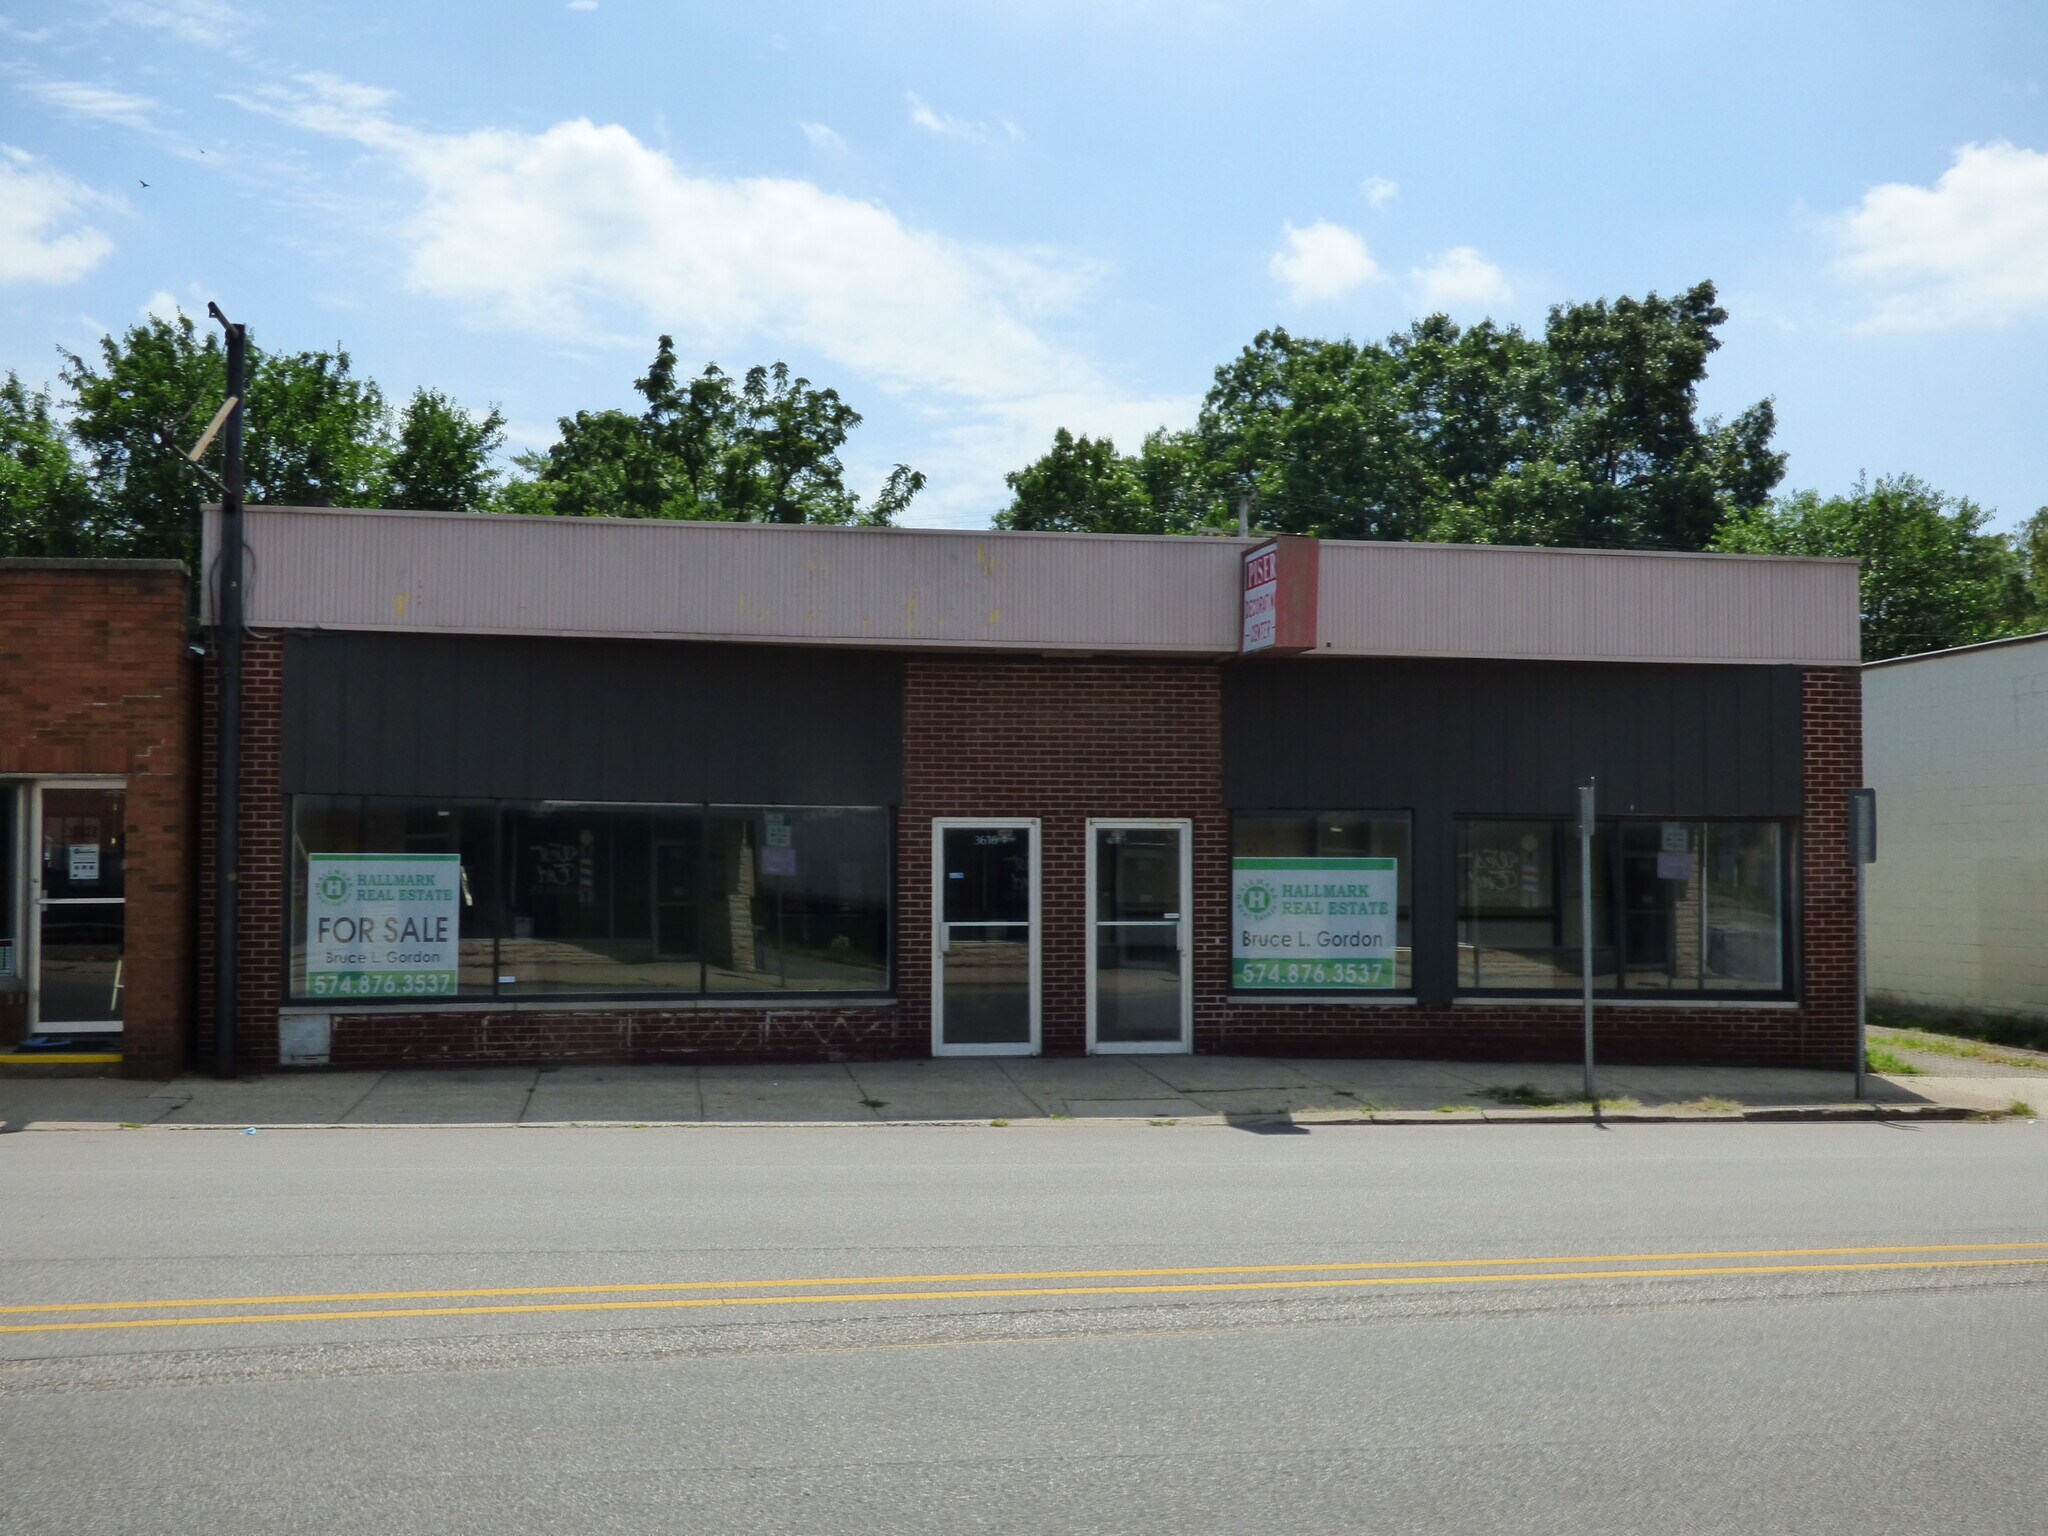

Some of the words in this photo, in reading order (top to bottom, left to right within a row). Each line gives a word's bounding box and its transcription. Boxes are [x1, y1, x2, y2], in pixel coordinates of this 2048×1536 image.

[357, 874, 436, 886] HALLMARK
[357, 889, 394, 901] REAL
[399, 889, 453, 901] ESTATE
[1281, 884, 1370, 898] HALLMARK
[1281, 901, 1324, 915] REAL
[1328, 901, 1389, 915] ESTATE
[318, 916, 374, 943] FOR
[384, 916, 448, 943] SALE
[1242, 931, 1292, 947] Bruce
[1299, 931, 1310, 947] L.
[1317, 931, 1383, 947] Gordon
[326, 951, 366, 964] Bruce
[372, 952, 381, 963] L.
[386, 951, 440, 964] Gordon
[1242, 963, 1383, 983] 574.876.3537
[314, 974, 450, 995] 574.876.3537
